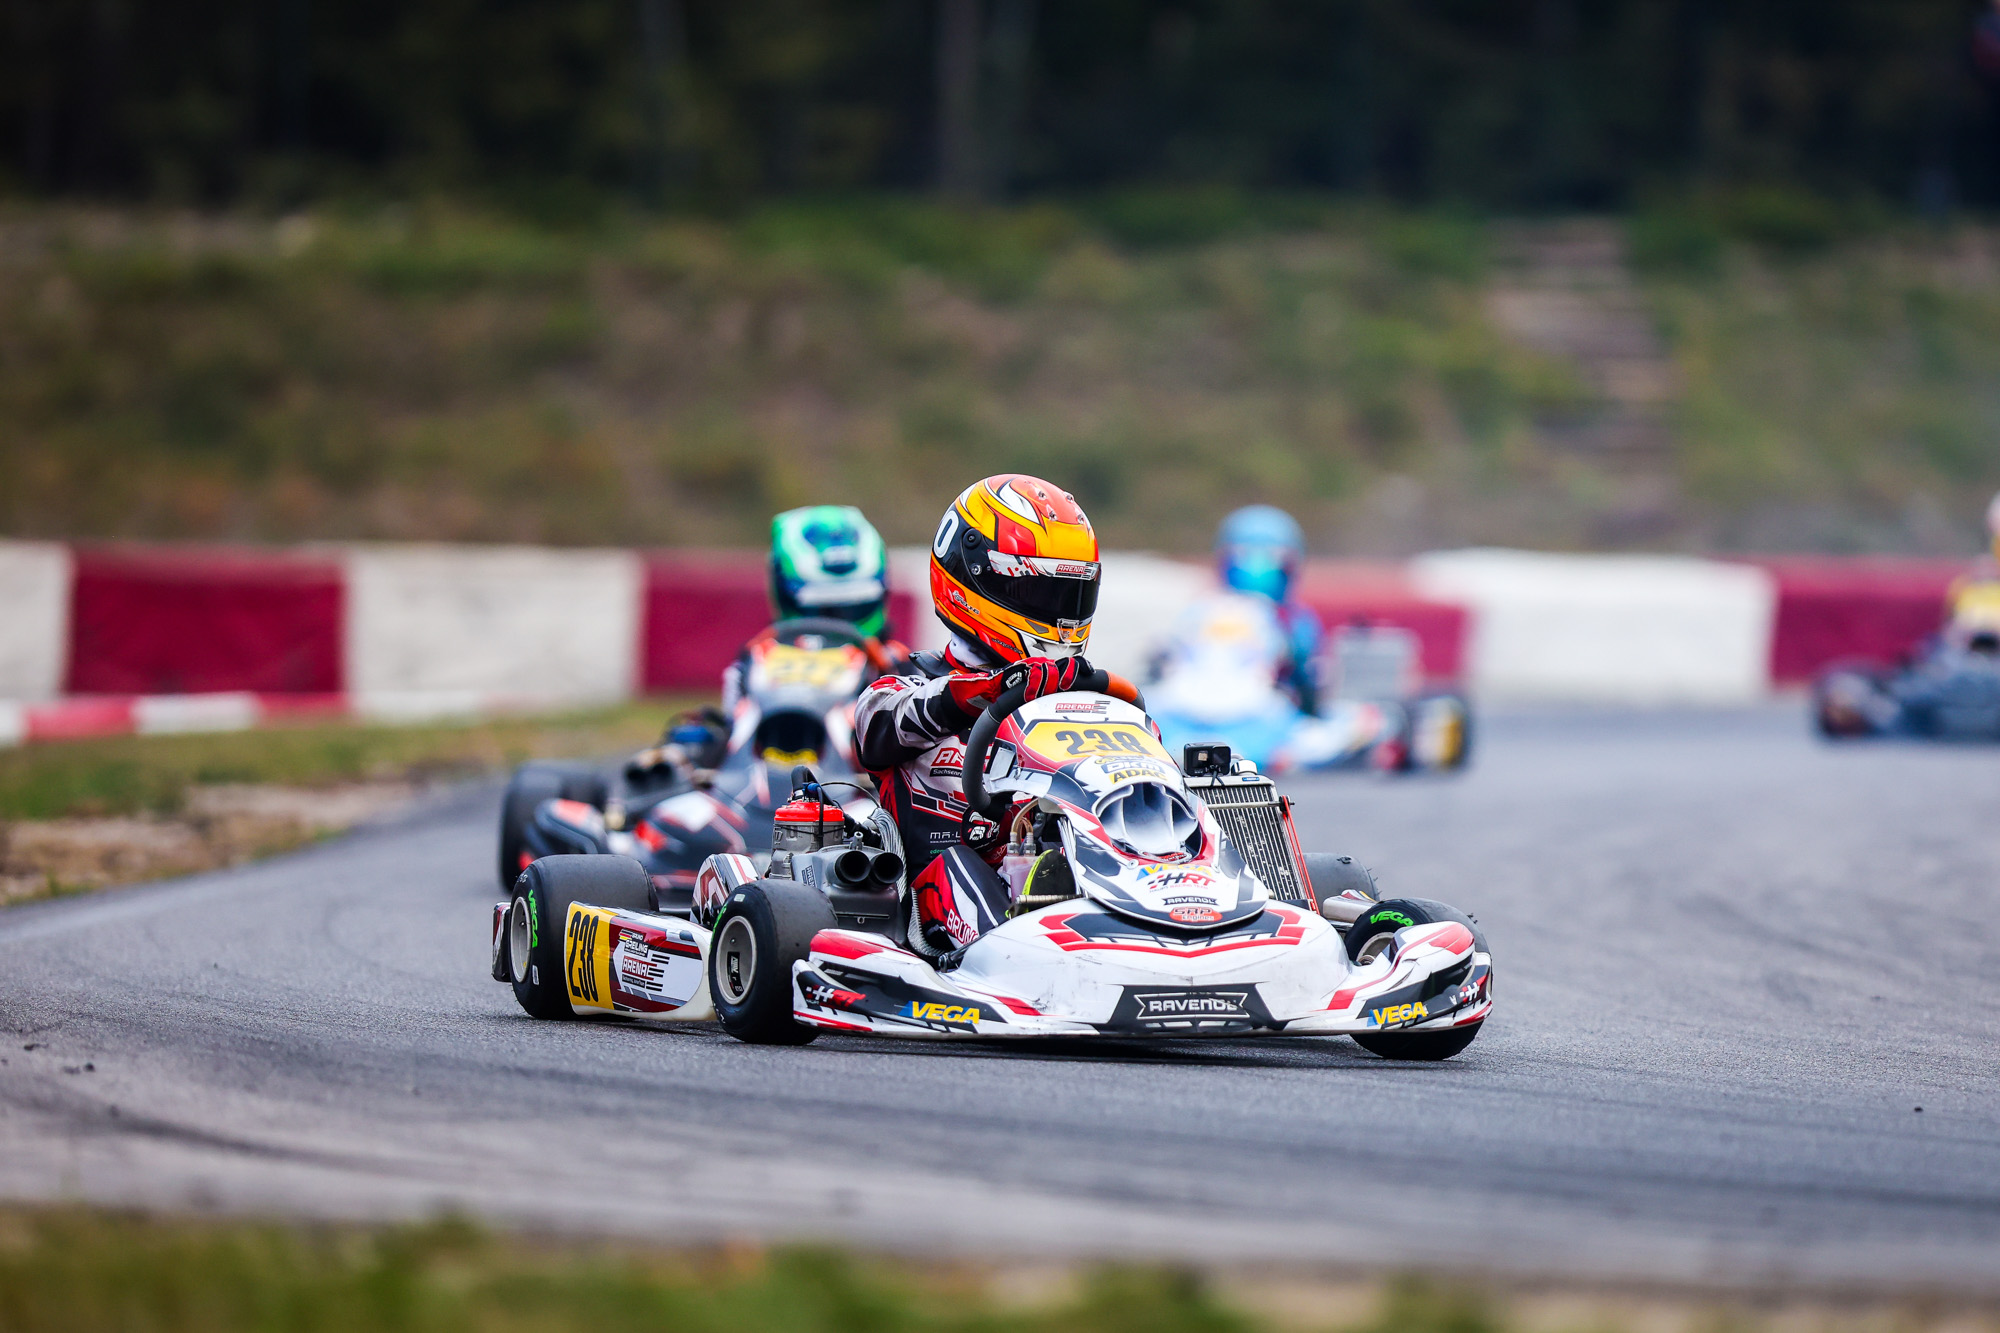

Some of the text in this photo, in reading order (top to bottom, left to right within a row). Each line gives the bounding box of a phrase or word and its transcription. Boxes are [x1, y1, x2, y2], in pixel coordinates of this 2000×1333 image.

[934, 510, 959, 558] 0
[1055, 729, 1153, 756] 238
[1113, 769, 1167, 783] ADAC
[528, 889, 538, 947] VEGA
[1370, 911, 1414, 927] VEGA
[568, 911, 600, 1002] 238
[912, 1001, 980, 1024] VEGA
[1149, 999, 1238, 1012] RAVENOL
[1373, 1001, 1428, 1025] VEGA
